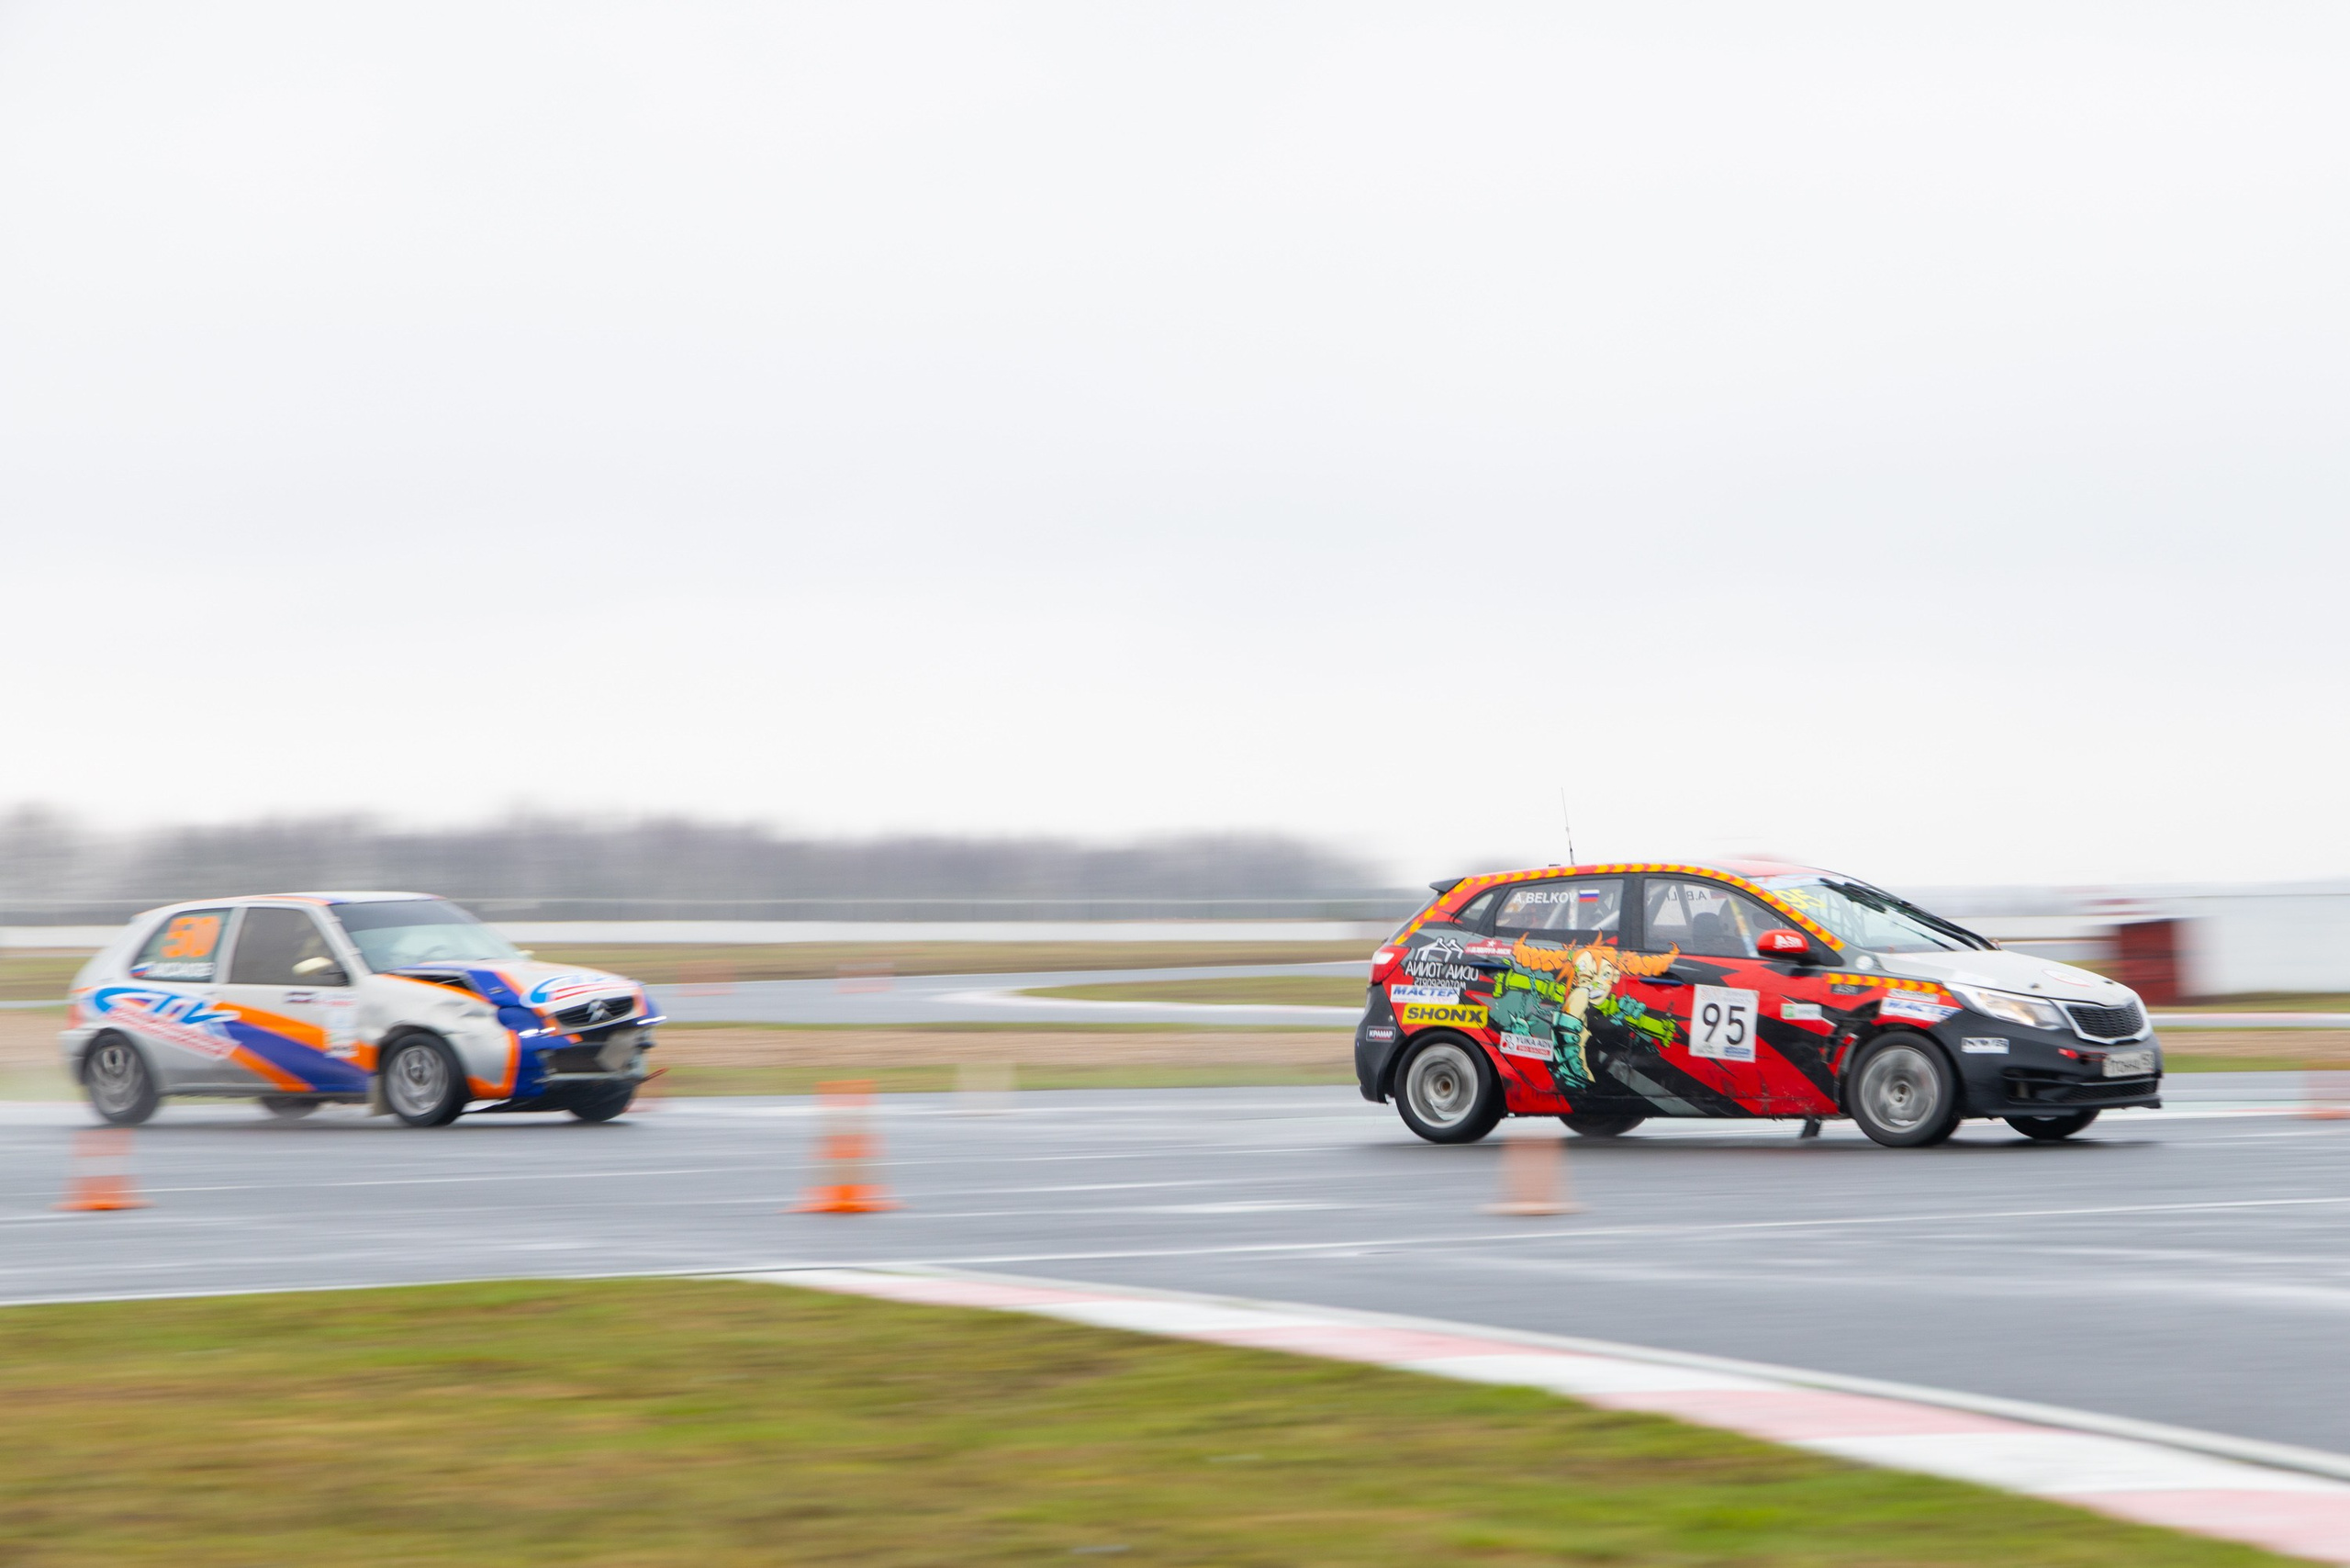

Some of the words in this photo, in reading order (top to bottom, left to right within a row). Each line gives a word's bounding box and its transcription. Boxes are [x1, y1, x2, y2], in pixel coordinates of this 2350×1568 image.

[1513, 891, 1577, 904] A.BELKOV
[1772, 888, 1827, 910] 95
[1406, 1007, 1483, 1024] SHONX
[1702, 1002, 1746, 1046] 95
